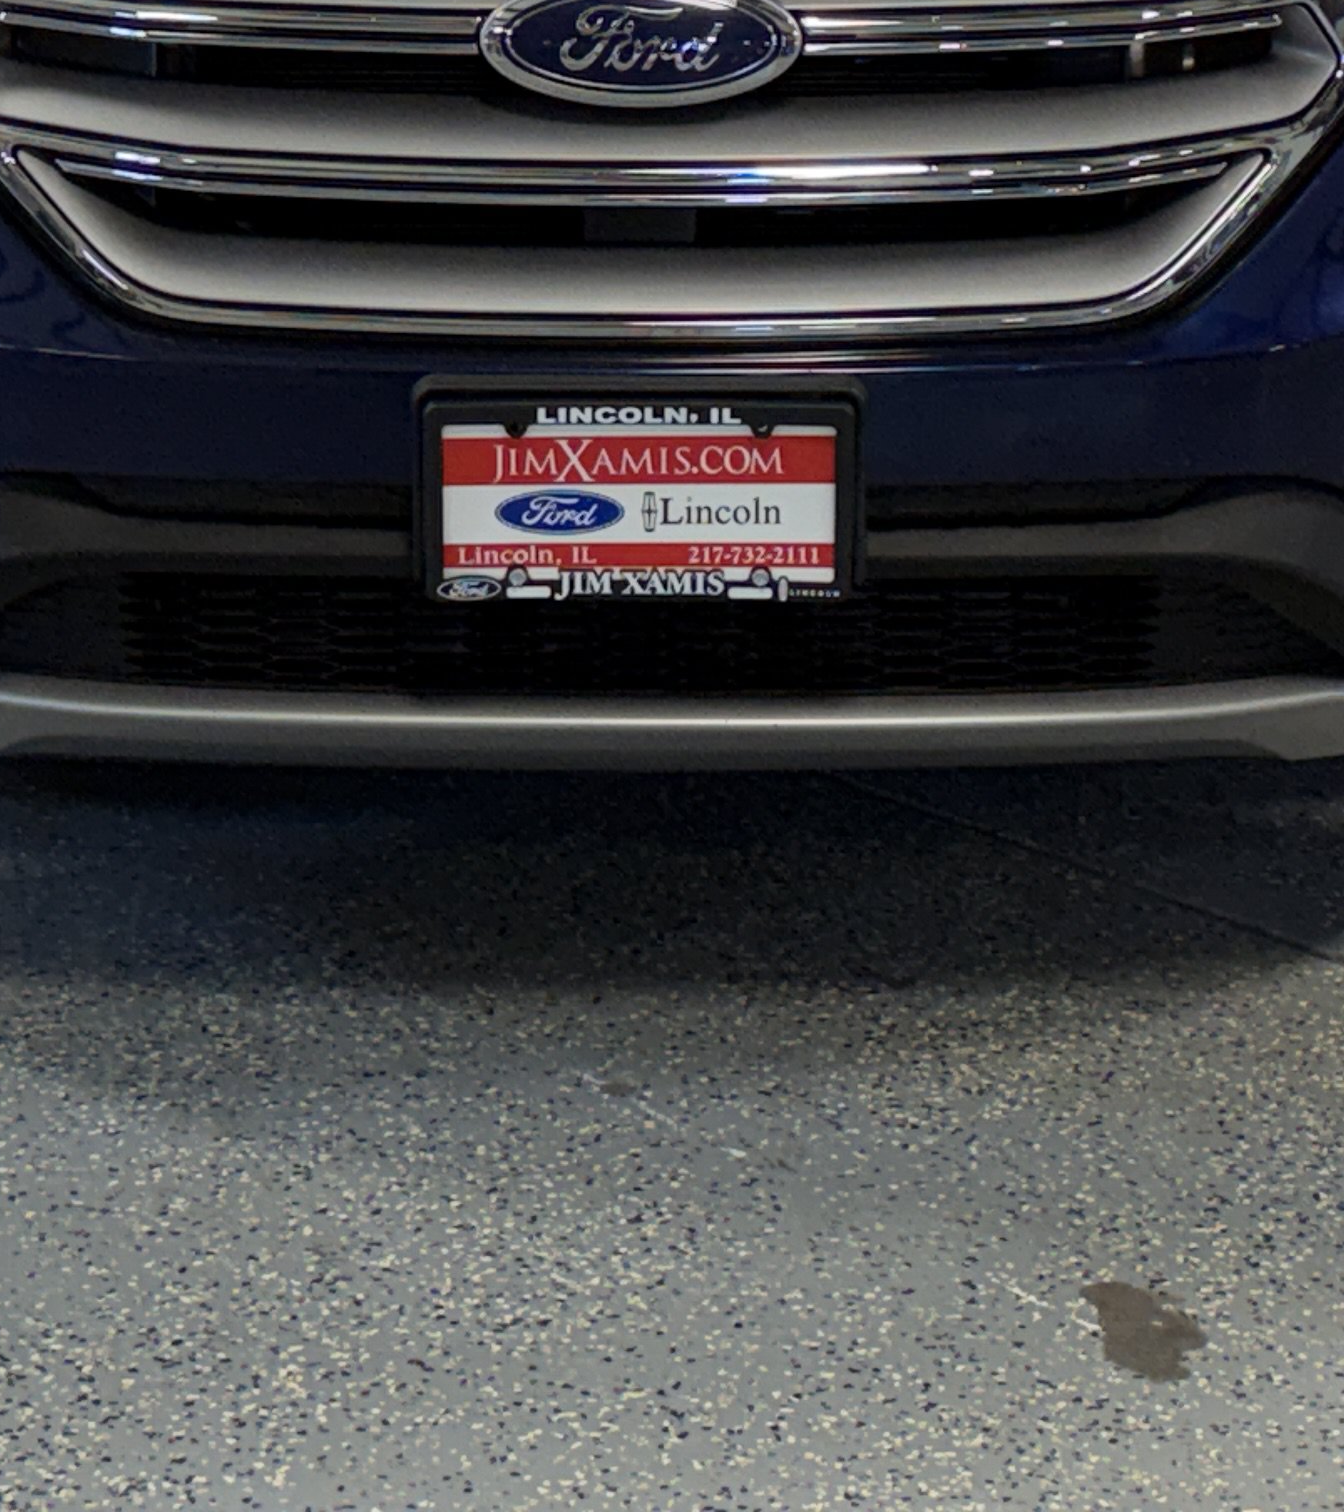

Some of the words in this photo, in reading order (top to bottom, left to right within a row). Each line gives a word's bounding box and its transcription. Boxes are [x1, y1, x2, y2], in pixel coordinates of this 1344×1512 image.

[559, 5, 724, 73] Ford
[536, 406, 699, 424] LINCOLN,
[709, 406, 742, 424] IL
[521, 495, 598, 527] Ford
[659, 496, 782, 526] Lincoln
[571, 545, 597, 564] IL
[688, 545, 821, 565] 217-732-2111
[554, 569, 613, 601] JIM
[620, 569, 725, 596] XAMIS
